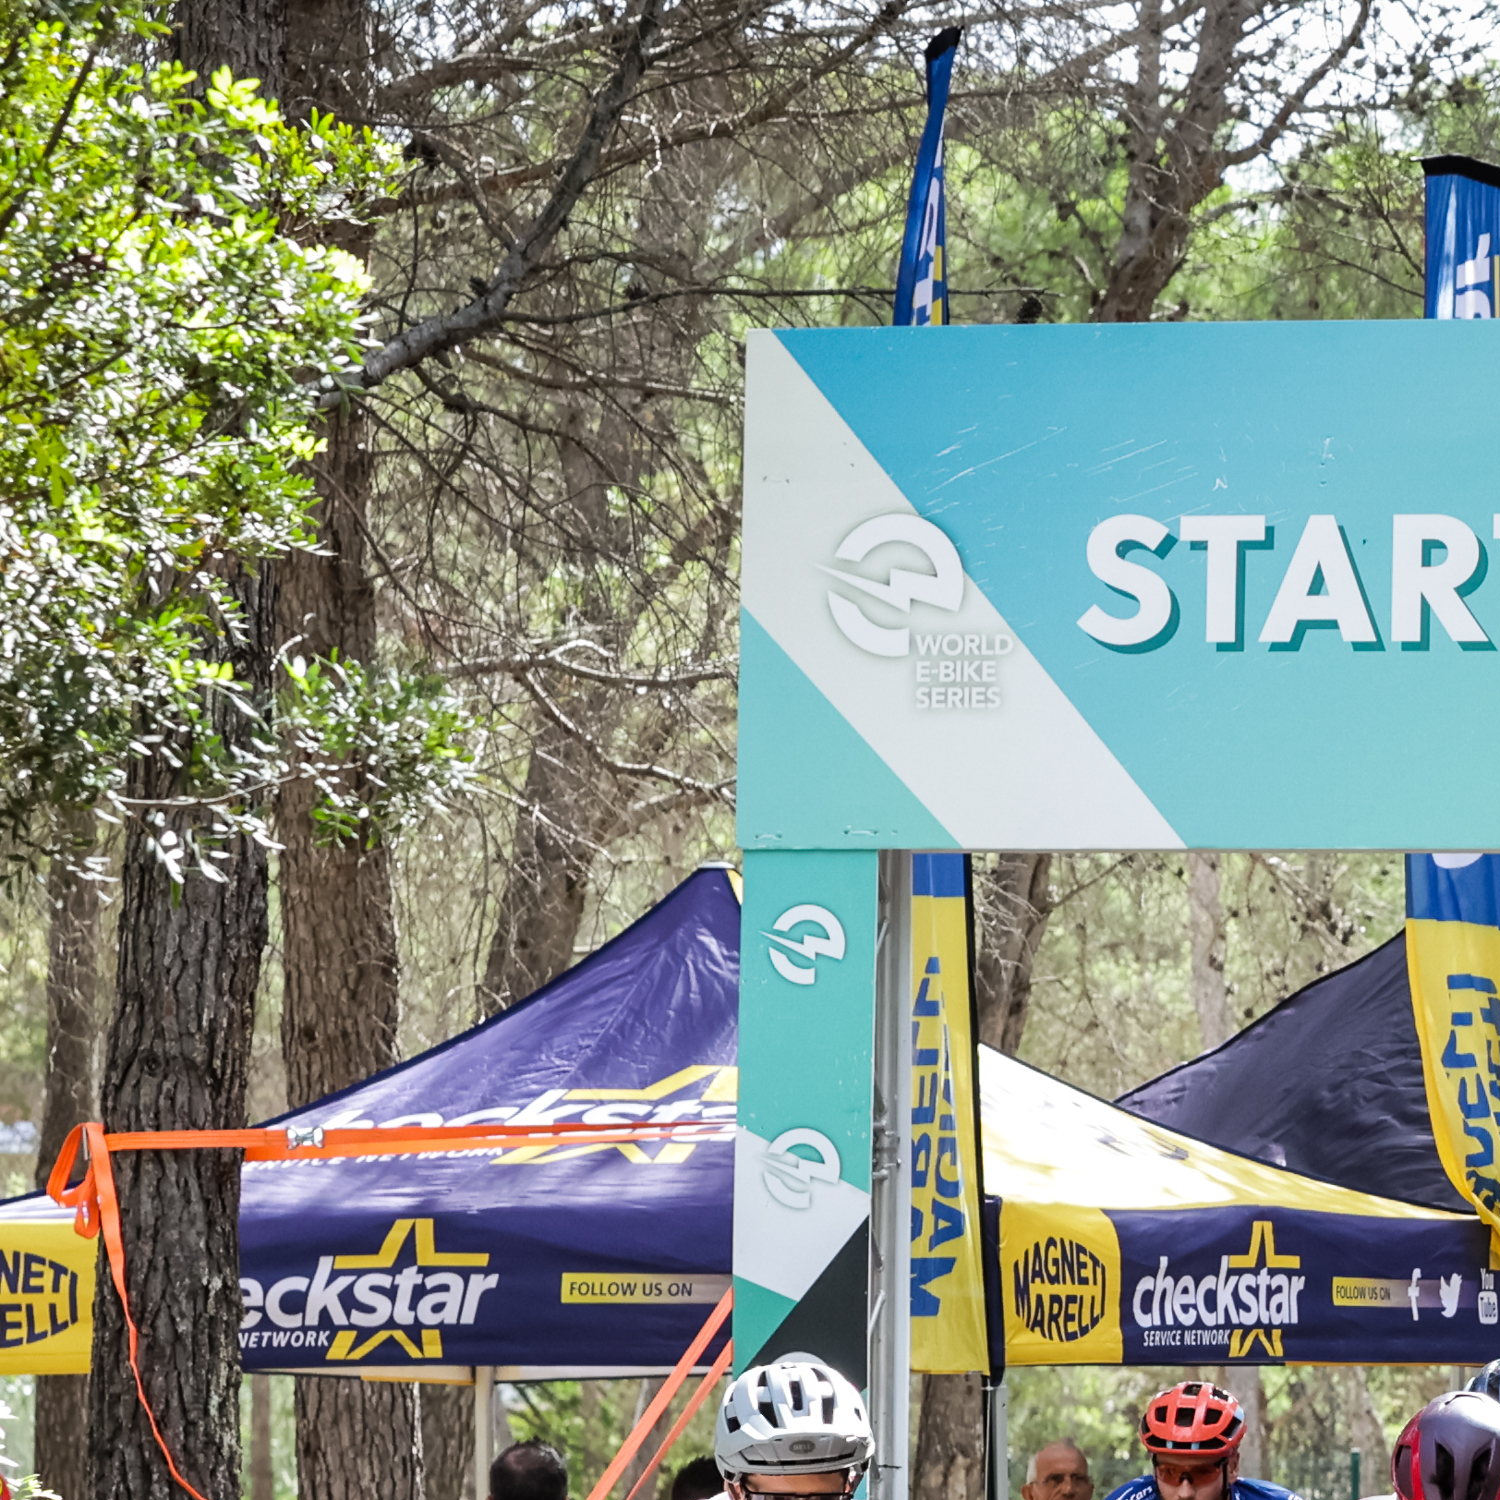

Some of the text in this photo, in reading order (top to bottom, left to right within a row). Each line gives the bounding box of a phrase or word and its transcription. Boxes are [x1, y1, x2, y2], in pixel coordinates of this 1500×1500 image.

[915, 634, 1013, 656] WORLD
[915, 661, 997, 682] E-BIKE
[915, 687, 1001, 709] SERIES
[0, 1249, 79, 1296] NETI
[1013, 1236, 1106, 1300] MAGNETI
[239, 1254, 500, 1328] eckstar
[569, 1280, 693, 1299] FOLLOW US ON
[1132, 1254, 1306, 1328] checkstar
[1335, 1284, 1391, 1302] FOLLOW US ON
[1015, 1288, 1106, 1343] MARELLI
[1143, 1329, 1231, 1347] SERVICE NETWORK
